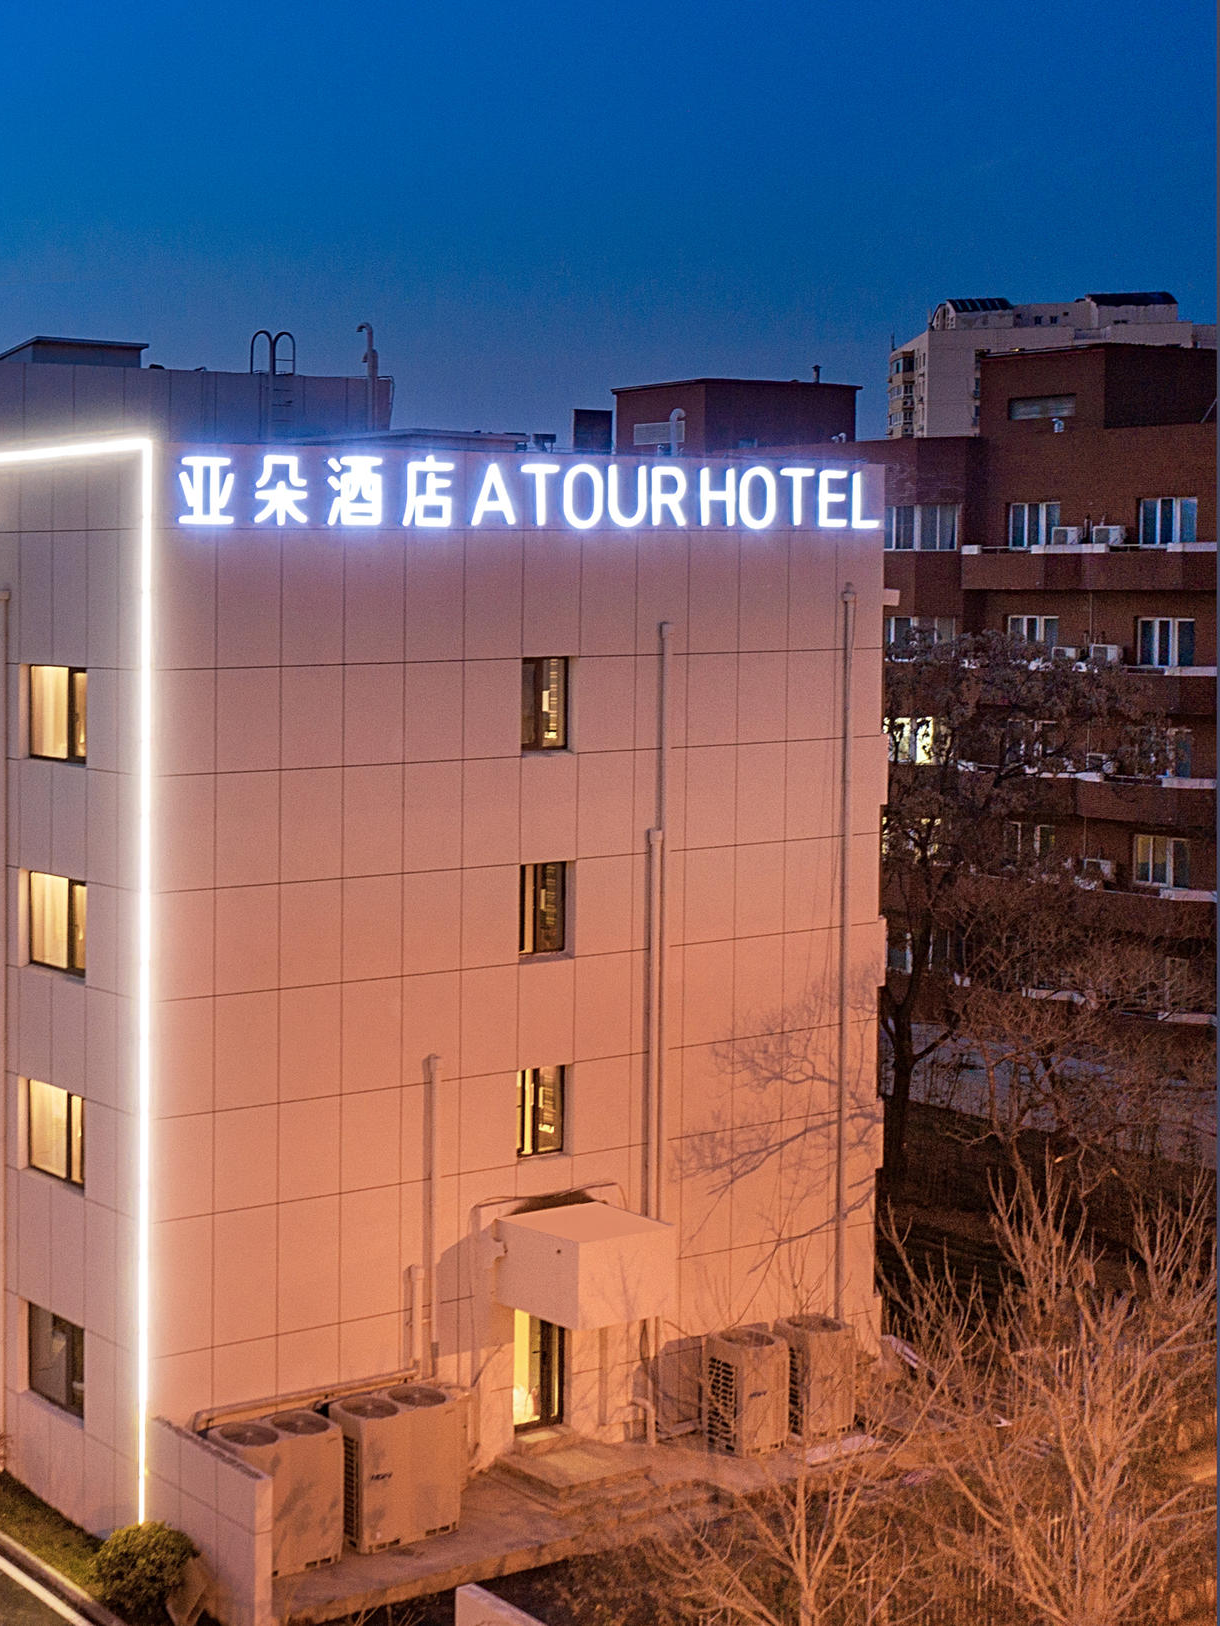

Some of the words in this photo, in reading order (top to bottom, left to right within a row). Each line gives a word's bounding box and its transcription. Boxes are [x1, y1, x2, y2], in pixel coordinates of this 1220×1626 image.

[178, 454, 456, 528] 亚朵酒店
[470, 462, 688, 530] ATOUR
[699, 466, 881, 531] HOTEL
